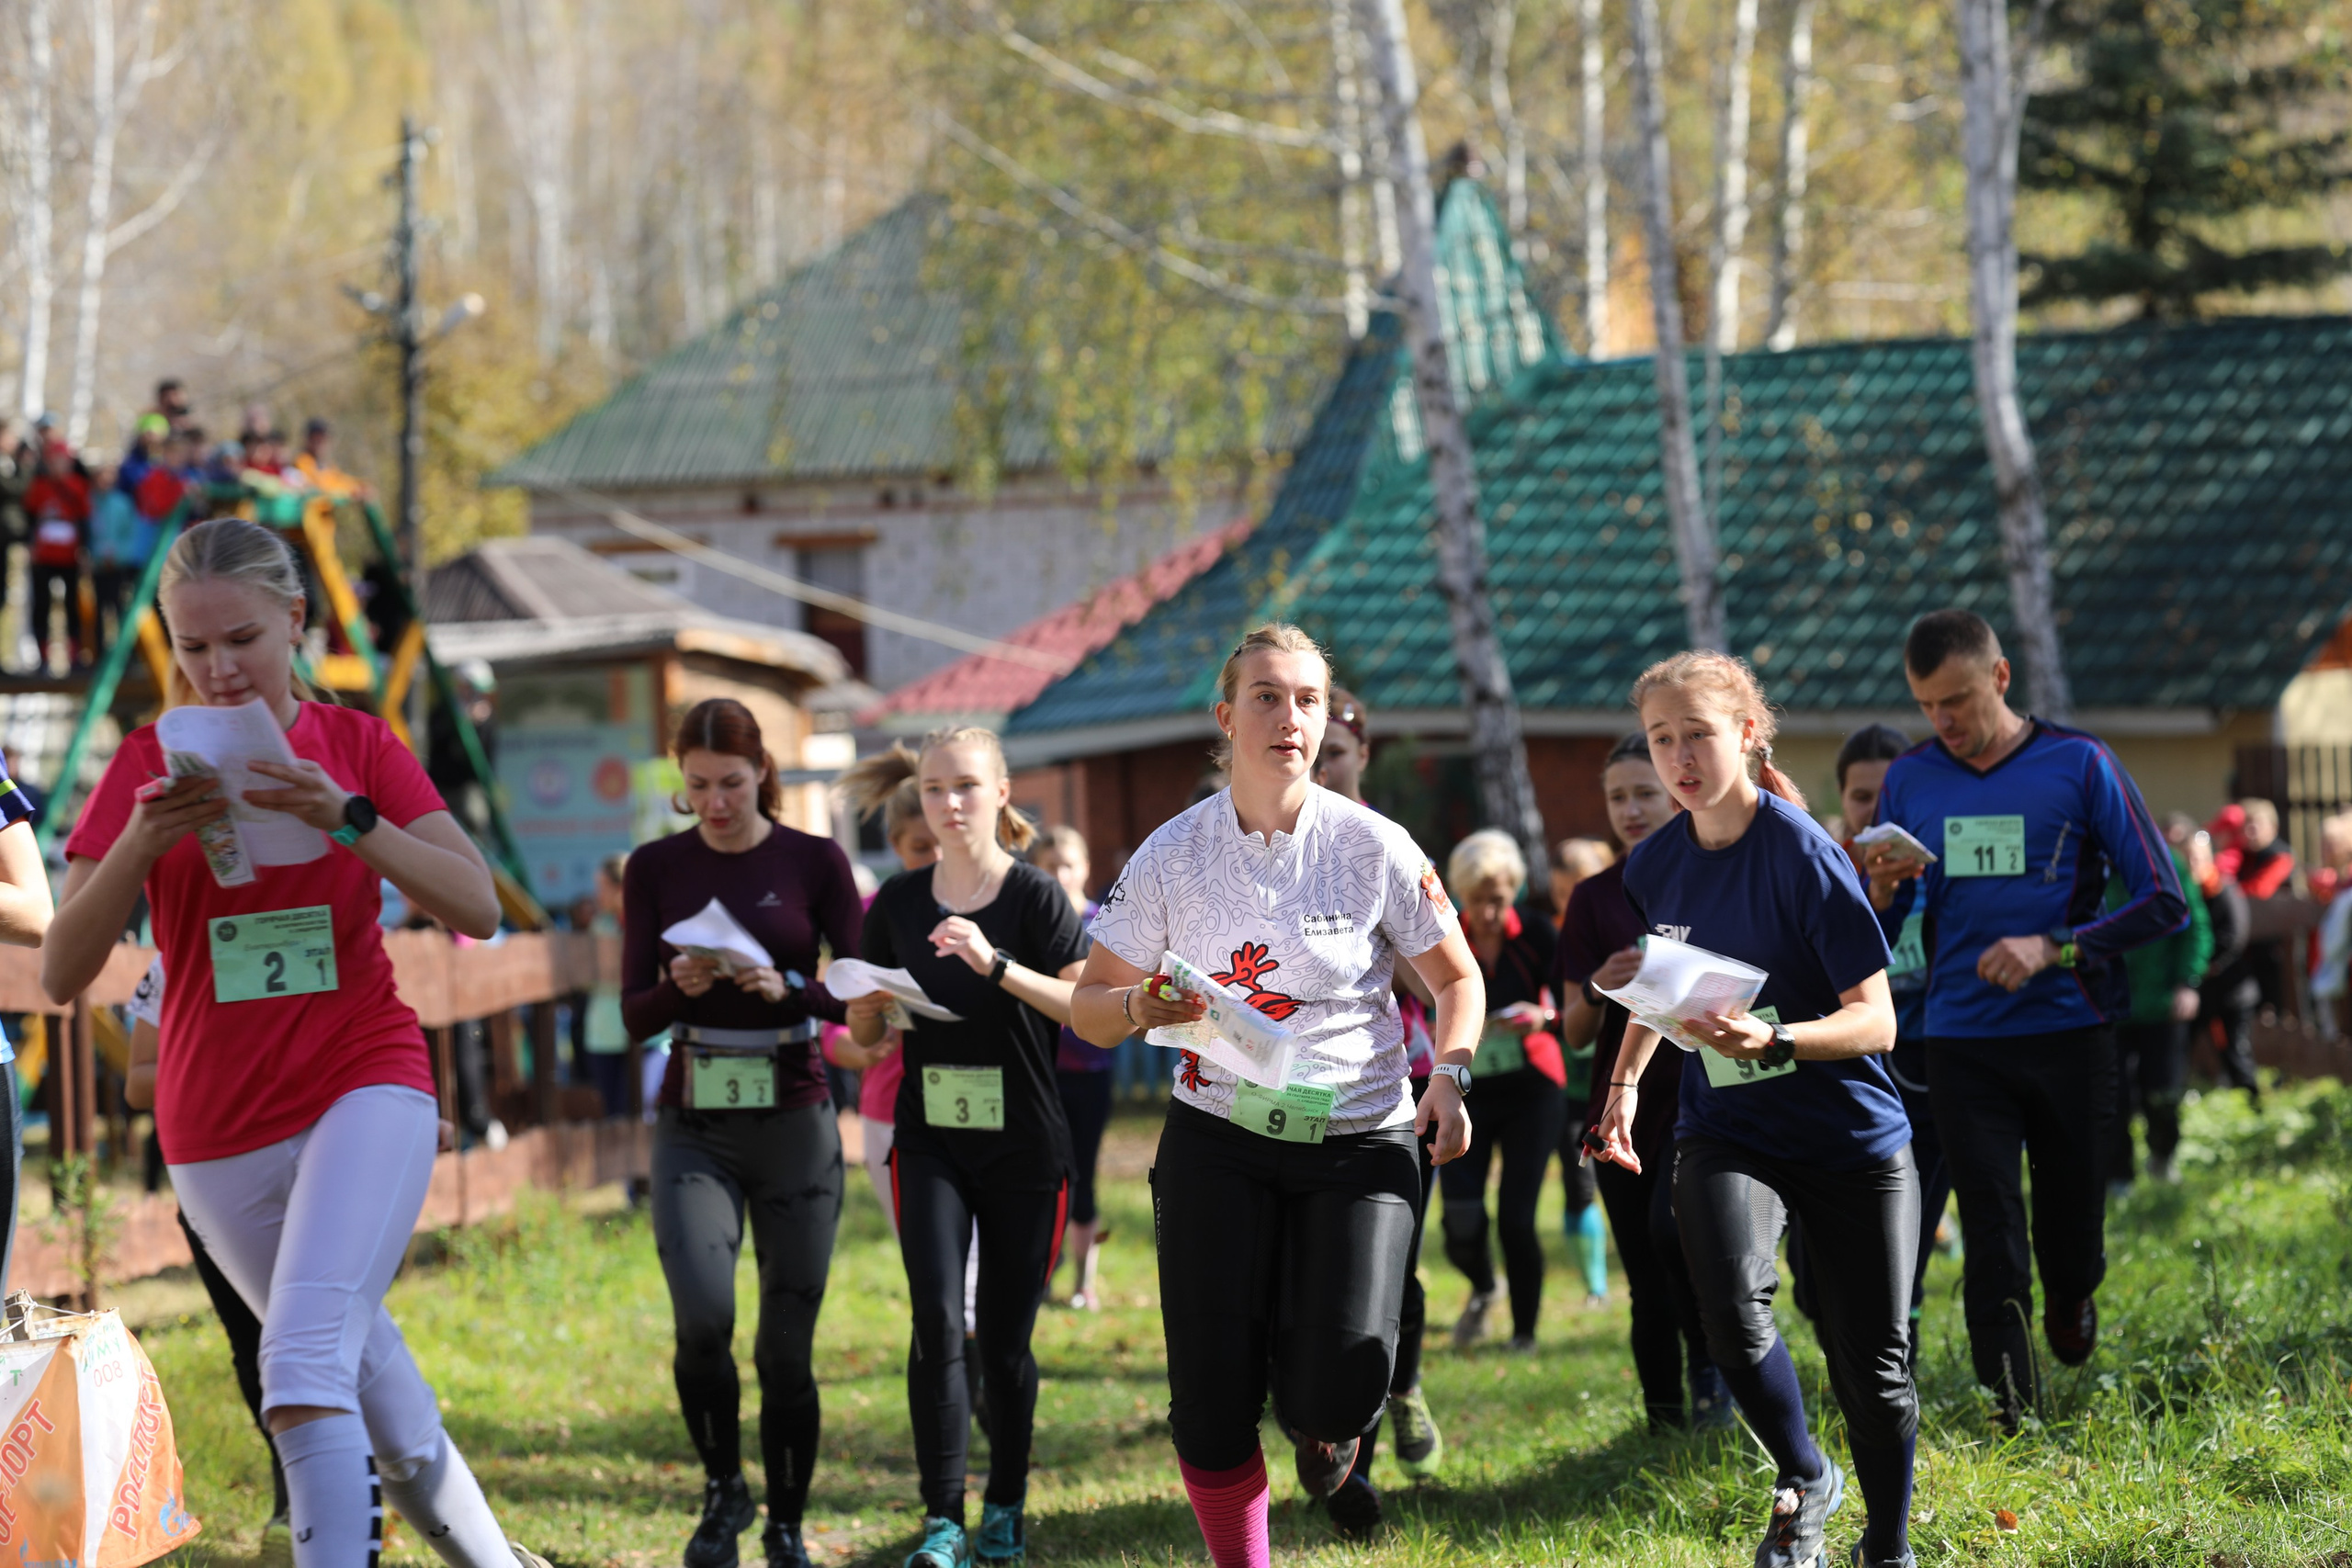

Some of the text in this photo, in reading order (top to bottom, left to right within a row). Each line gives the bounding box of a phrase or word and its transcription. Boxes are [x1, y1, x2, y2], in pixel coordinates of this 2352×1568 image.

[1974, 845, 1995, 872] 11
[2009, 852, 2017, 871] 2
[1304, 912, 1352, 923] Сабинина
[1304, 926, 1354, 937] Елизавета
[1898, 942, 1921, 968] 11
[264, 951, 287, 993] 2
[316, 958, 327, 986] 1
[726, 1078, 741, 1104] 3
[757, 1085, 766, 1103] 2
[1250, 1091, 1280, 1108] О-ФИРМА
[1302, 1089, 1331, 1099] ДЕСЯТКА
[955, 1097, 970, 1124] 3
[989, 1105, 997, 1123] 1
[1304, 1115, 1326, 1123] ЭТАП
[1266, 1109, 1286, 1135] 9
[1309, 1123, 1317, 1142] 1
[94, 1360, 123, 1387] 008
